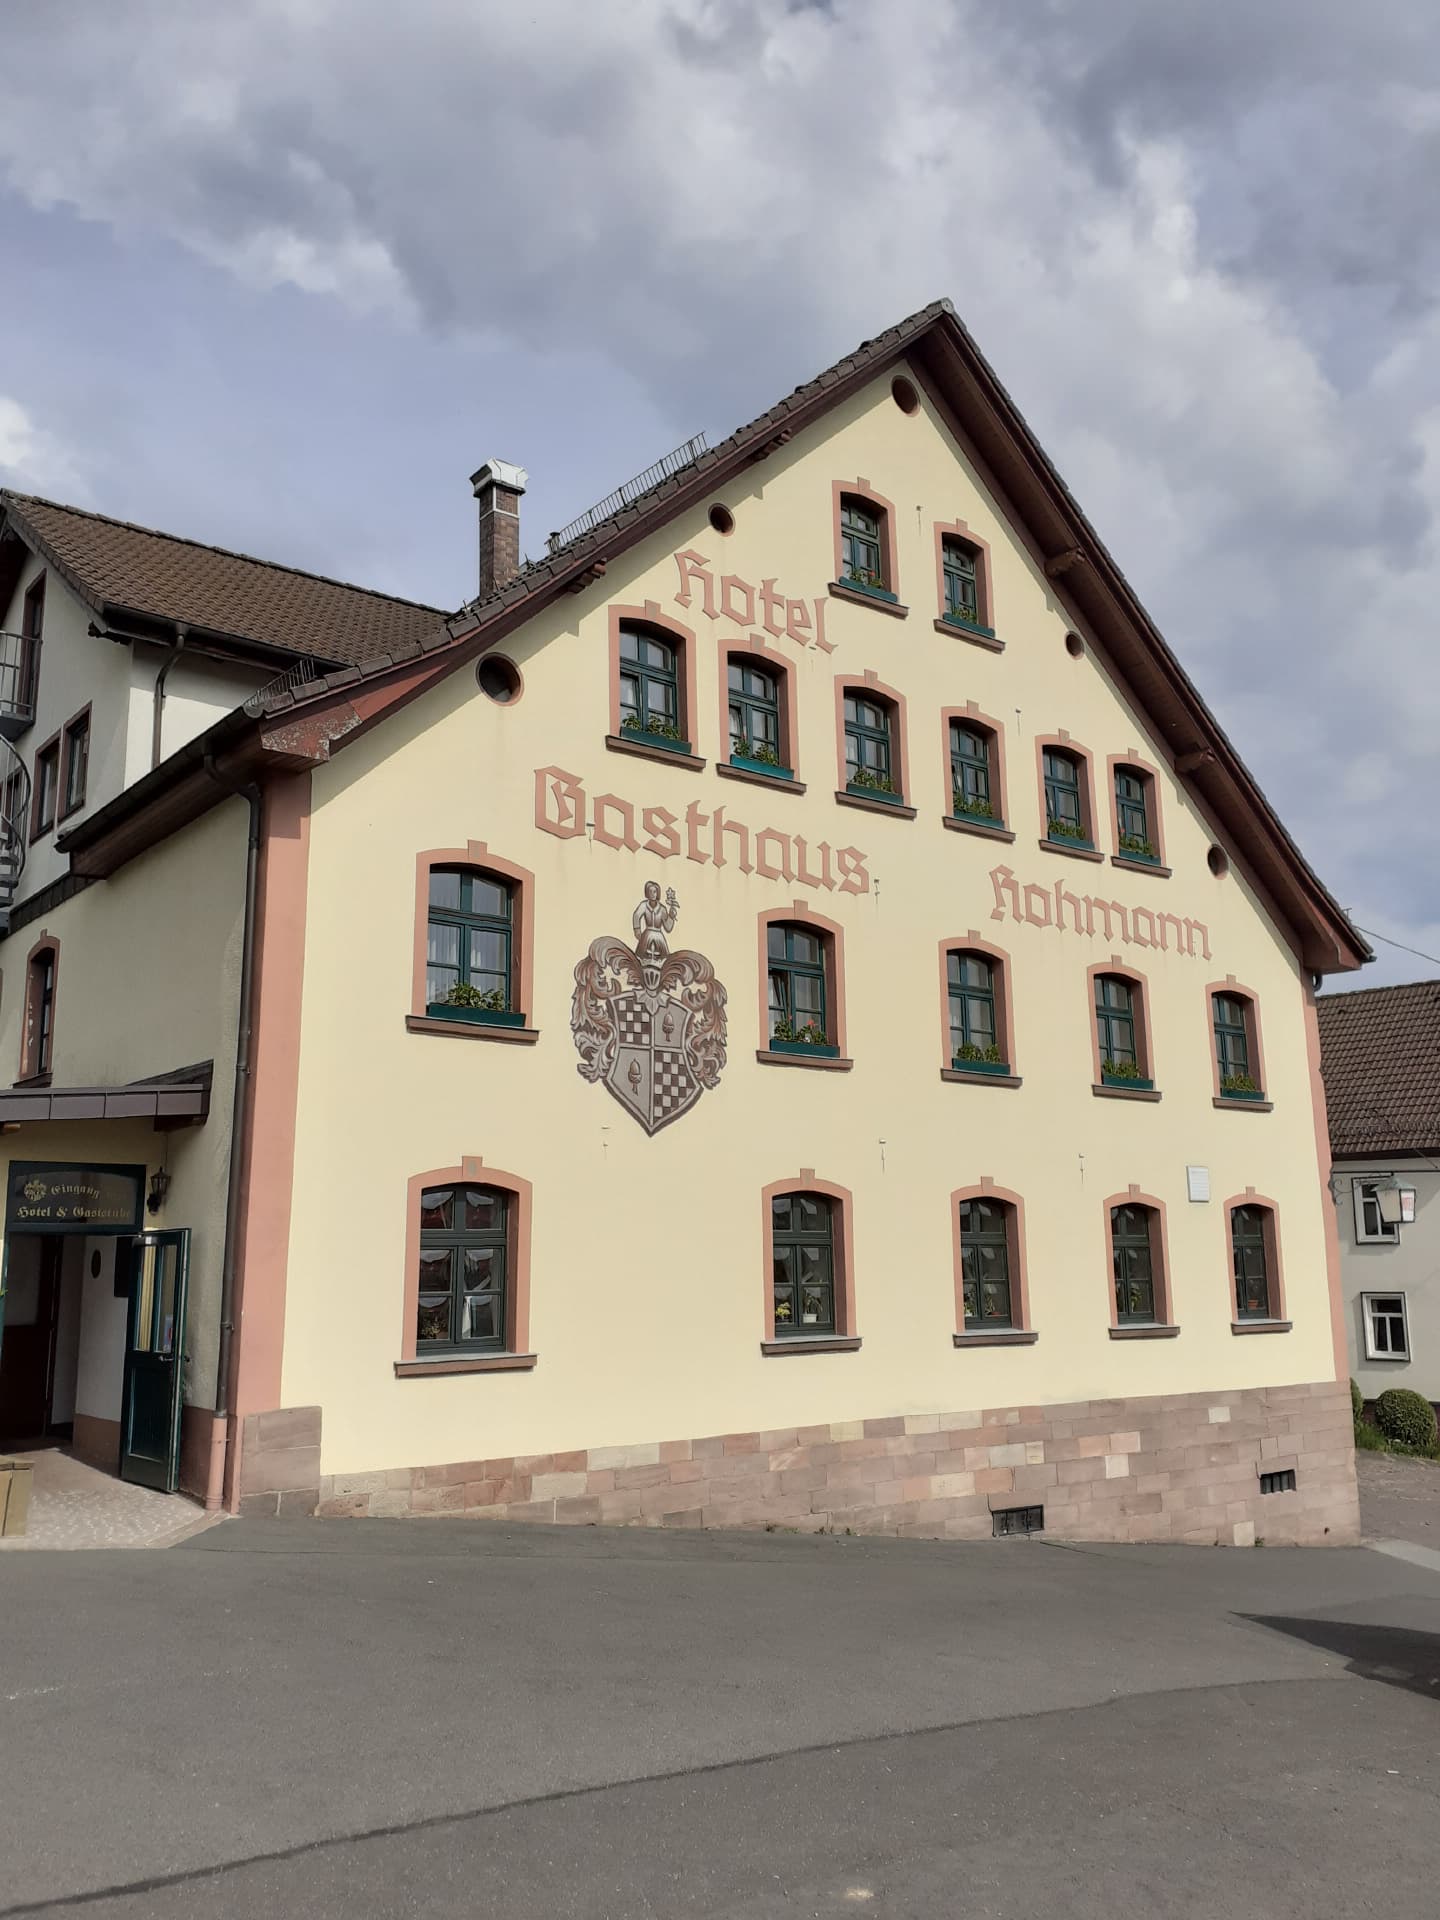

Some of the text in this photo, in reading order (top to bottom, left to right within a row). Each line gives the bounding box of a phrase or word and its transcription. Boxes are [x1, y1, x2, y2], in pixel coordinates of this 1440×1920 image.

[674, 549, 838, 654] Hotel
[534, 765, 870, 896] Gasthaus
[989, 864, 1213, 960] Hohmann
[17, 1206, 51, 1218] Hotel
[56, 1206, 68, 1218] &
[50, 1183, 101, 1200] Eingang
